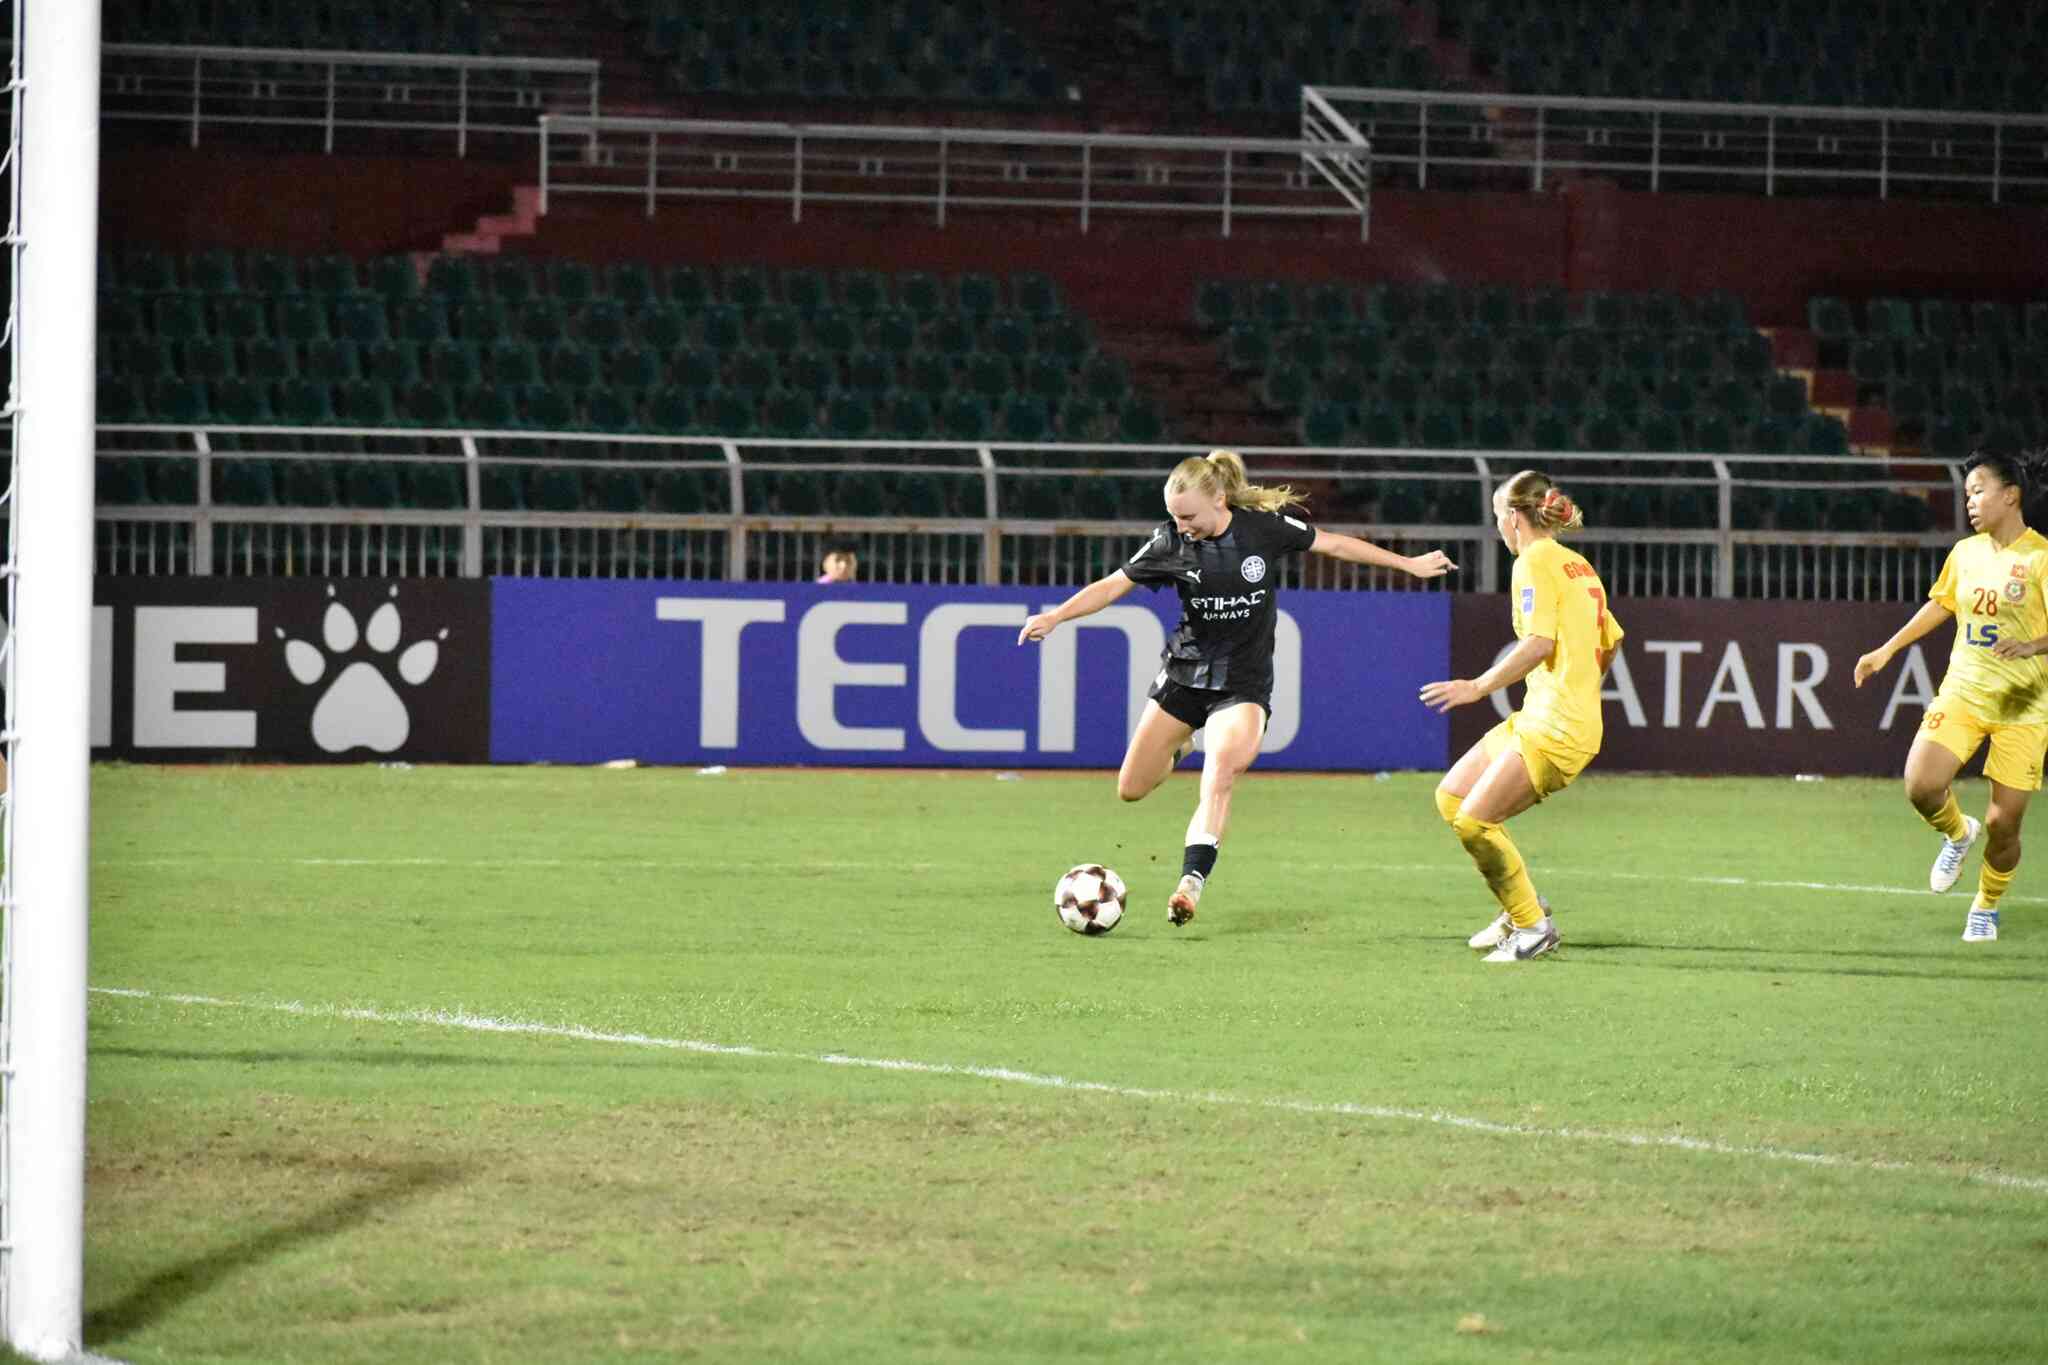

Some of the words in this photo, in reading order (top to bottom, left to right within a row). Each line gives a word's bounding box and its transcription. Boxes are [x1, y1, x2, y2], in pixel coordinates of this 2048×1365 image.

[1202, 608, 1250, 621] AIRWAYS
[1972, 587, 1998, 617] 28
[1966, 623, 1998, 648] LS
[656, 597, 1302, 754] TECN
